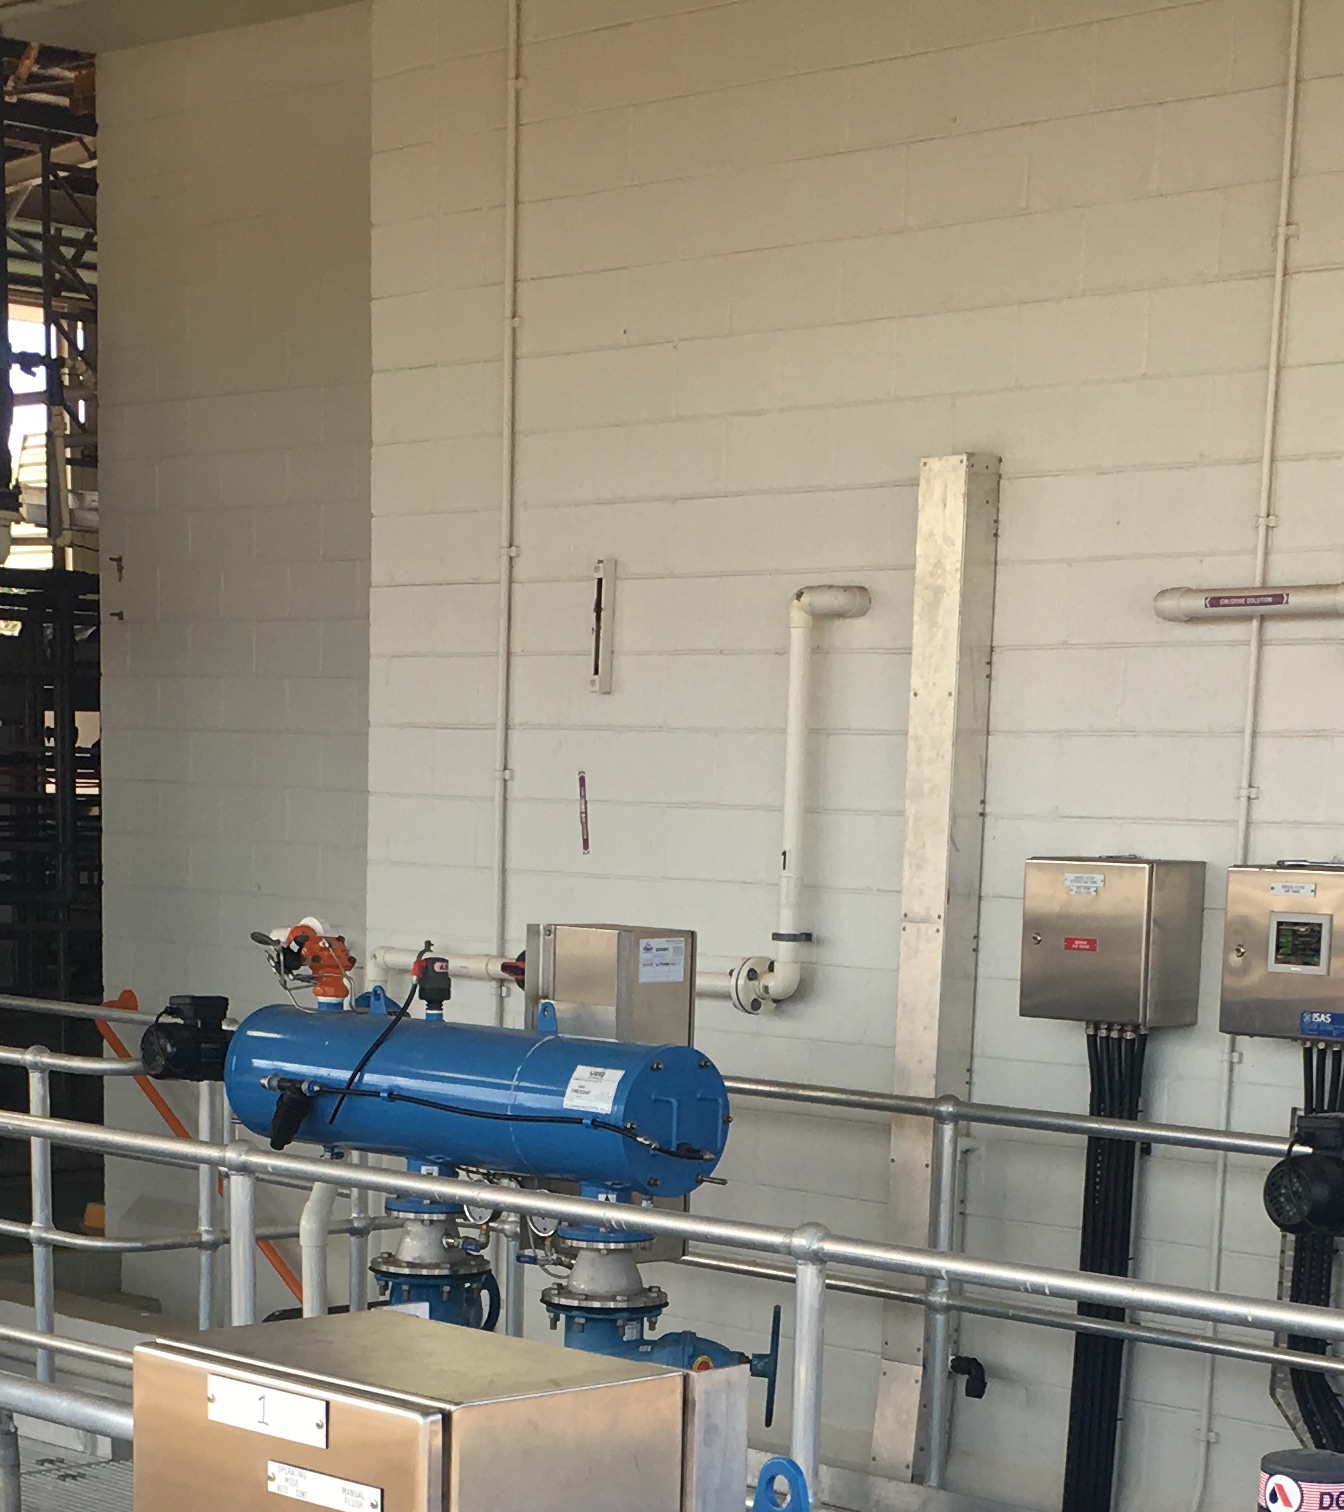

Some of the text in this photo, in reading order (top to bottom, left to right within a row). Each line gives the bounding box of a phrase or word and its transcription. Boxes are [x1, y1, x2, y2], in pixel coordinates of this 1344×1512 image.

[1312, 1013, 1331, 1022] ISAS
[257, 1395, 269, 1425] 1
[284, 1476, 299, 1487] MODE
[341, 1487, 365, 1500] MANUAL
